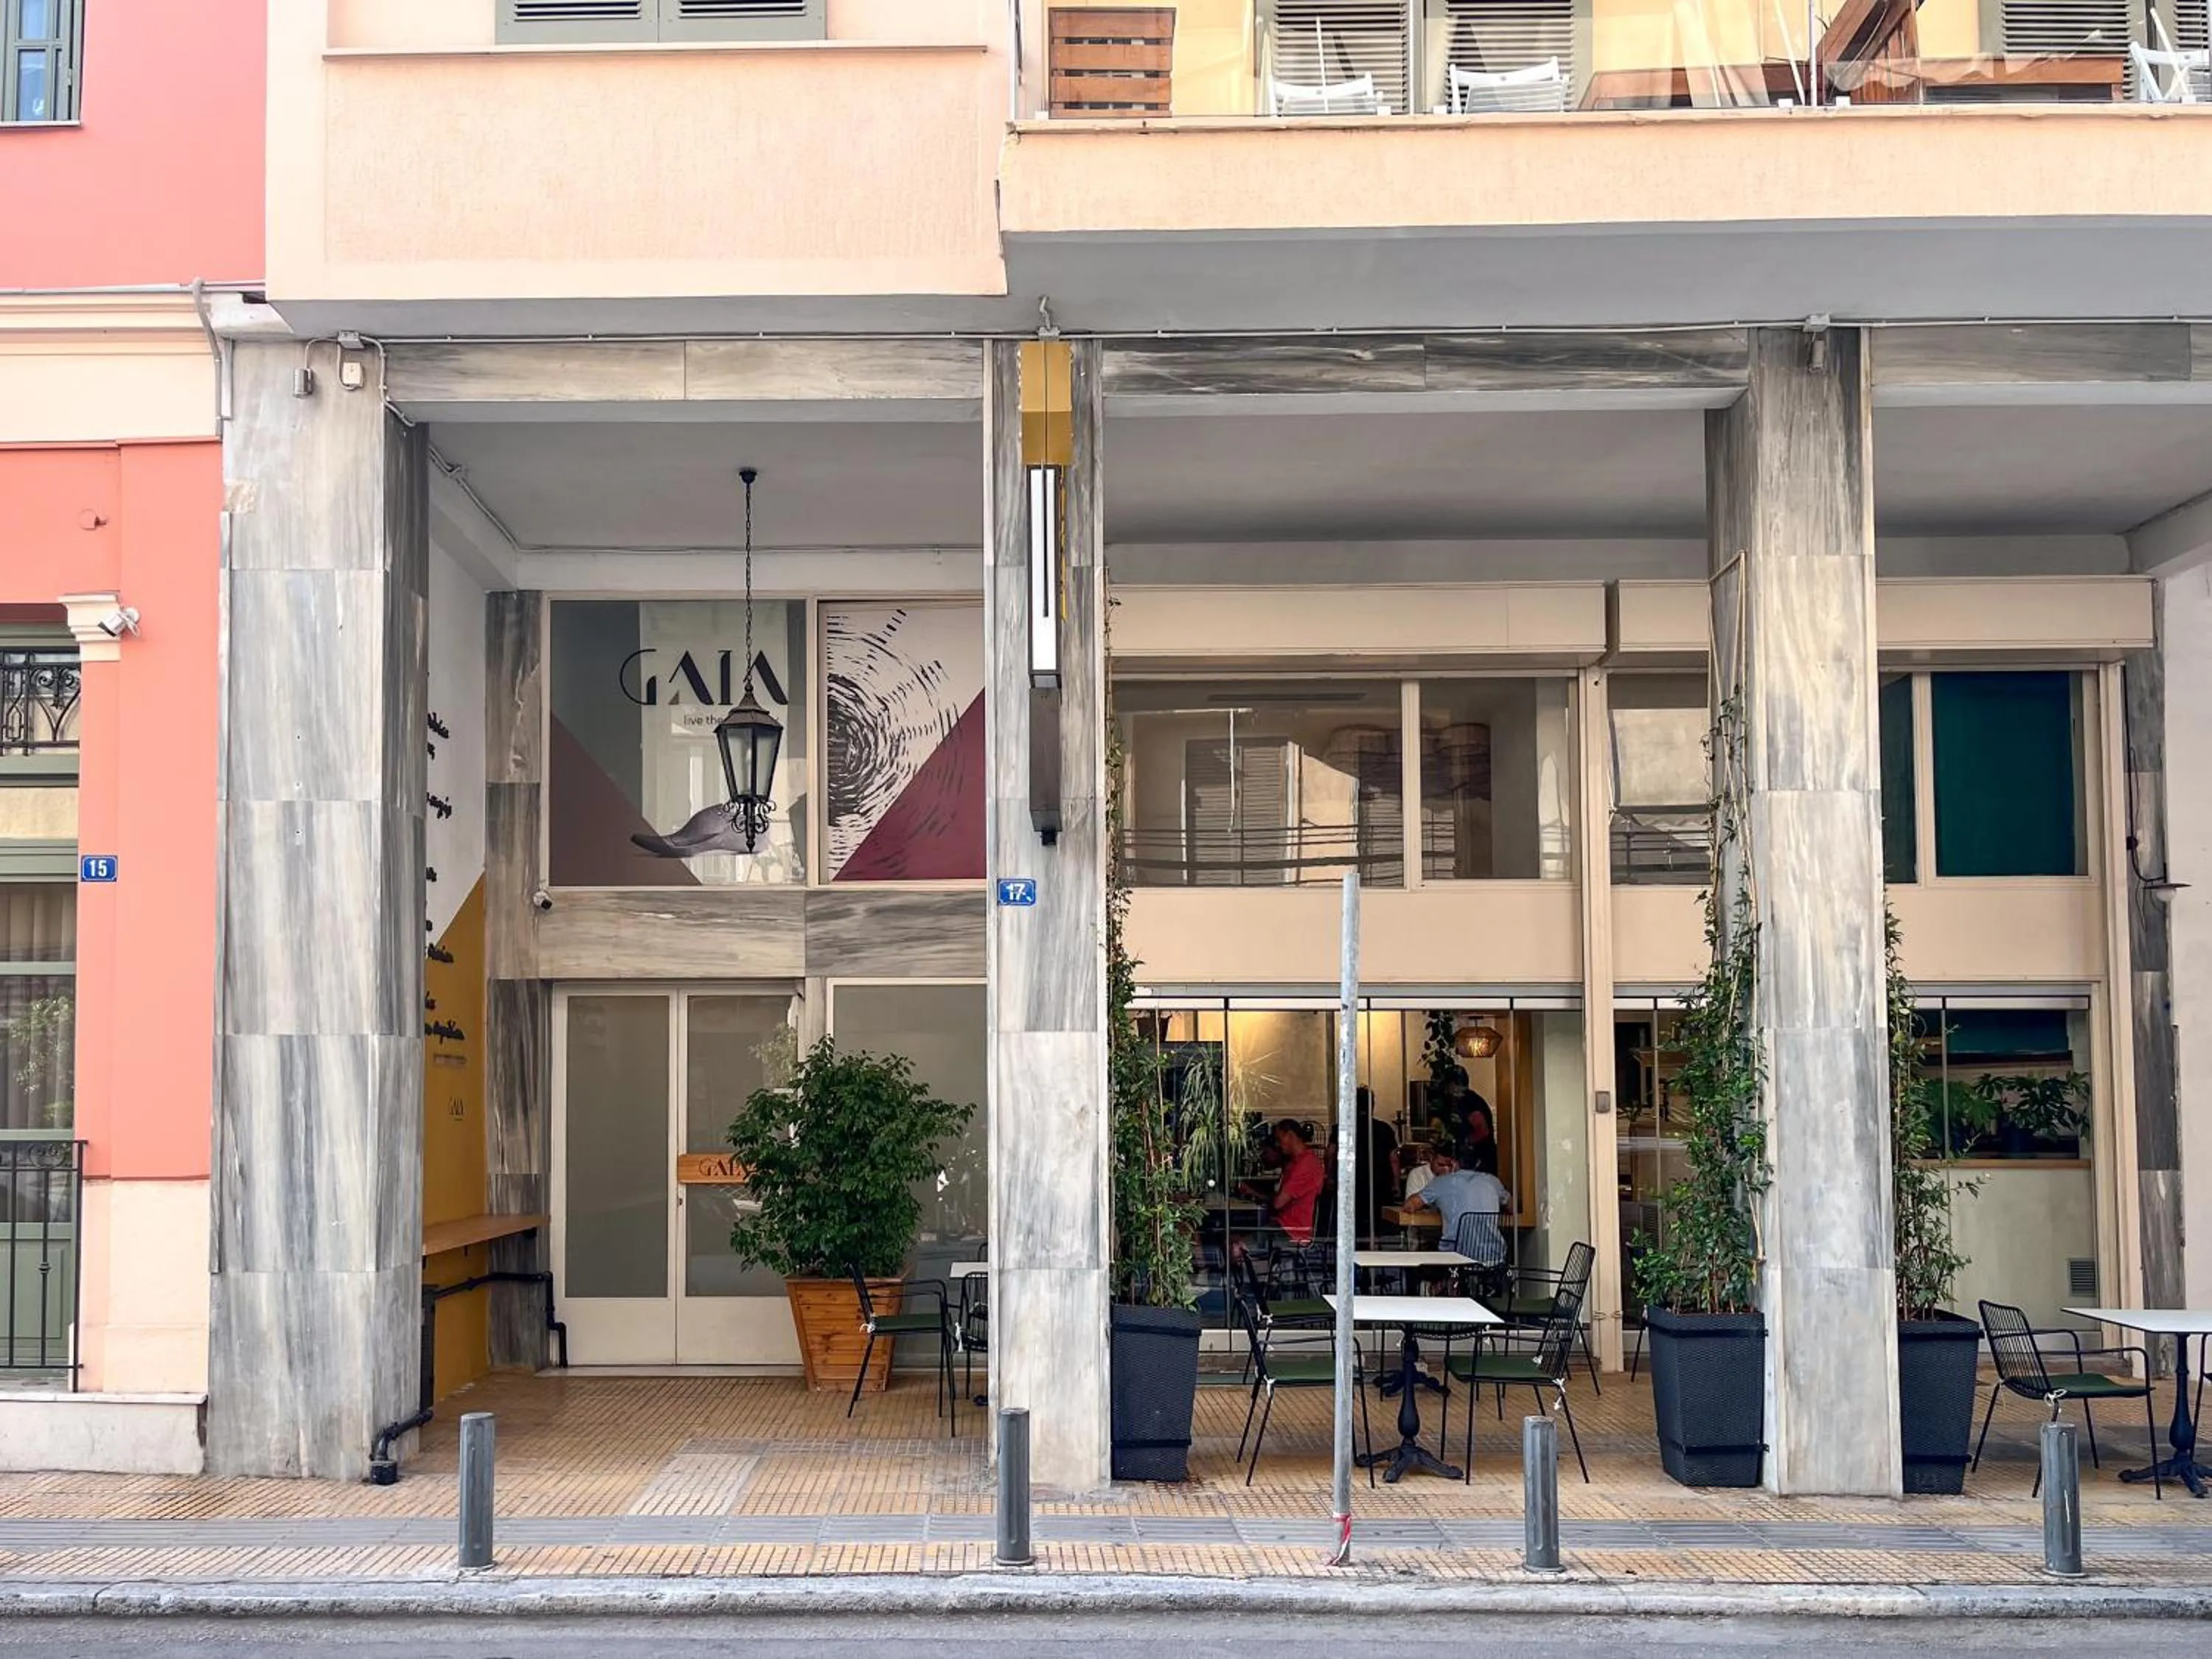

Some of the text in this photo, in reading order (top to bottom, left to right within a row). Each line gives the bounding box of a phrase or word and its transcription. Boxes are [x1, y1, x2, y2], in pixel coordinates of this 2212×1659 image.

[619, 648, 788, 705] GAIA
[684, 714, 703, 725] live
[90, 859, 107, 877] 15
[1005, 883, 1026, 900] 17
